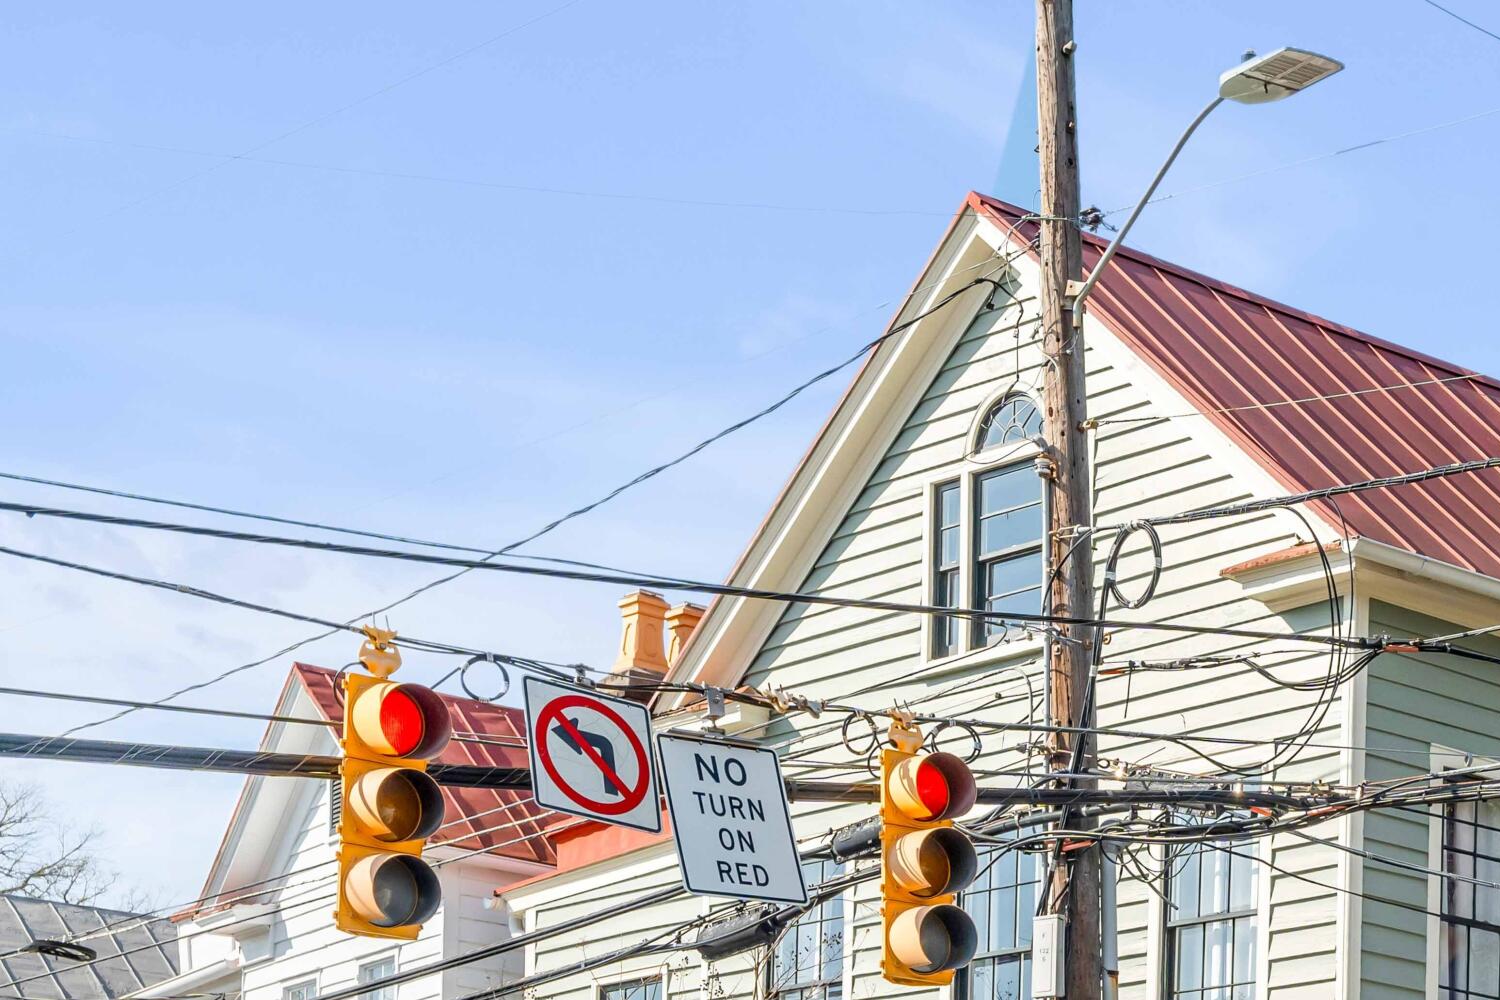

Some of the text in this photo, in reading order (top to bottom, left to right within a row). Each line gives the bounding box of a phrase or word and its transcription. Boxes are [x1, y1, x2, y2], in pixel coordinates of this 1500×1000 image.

[694, 753, 747, 786] NO
[692, 791, 765, 822] TURN
[719, 827, 755, 853] ON
[716, 860, 770, 887] RED
